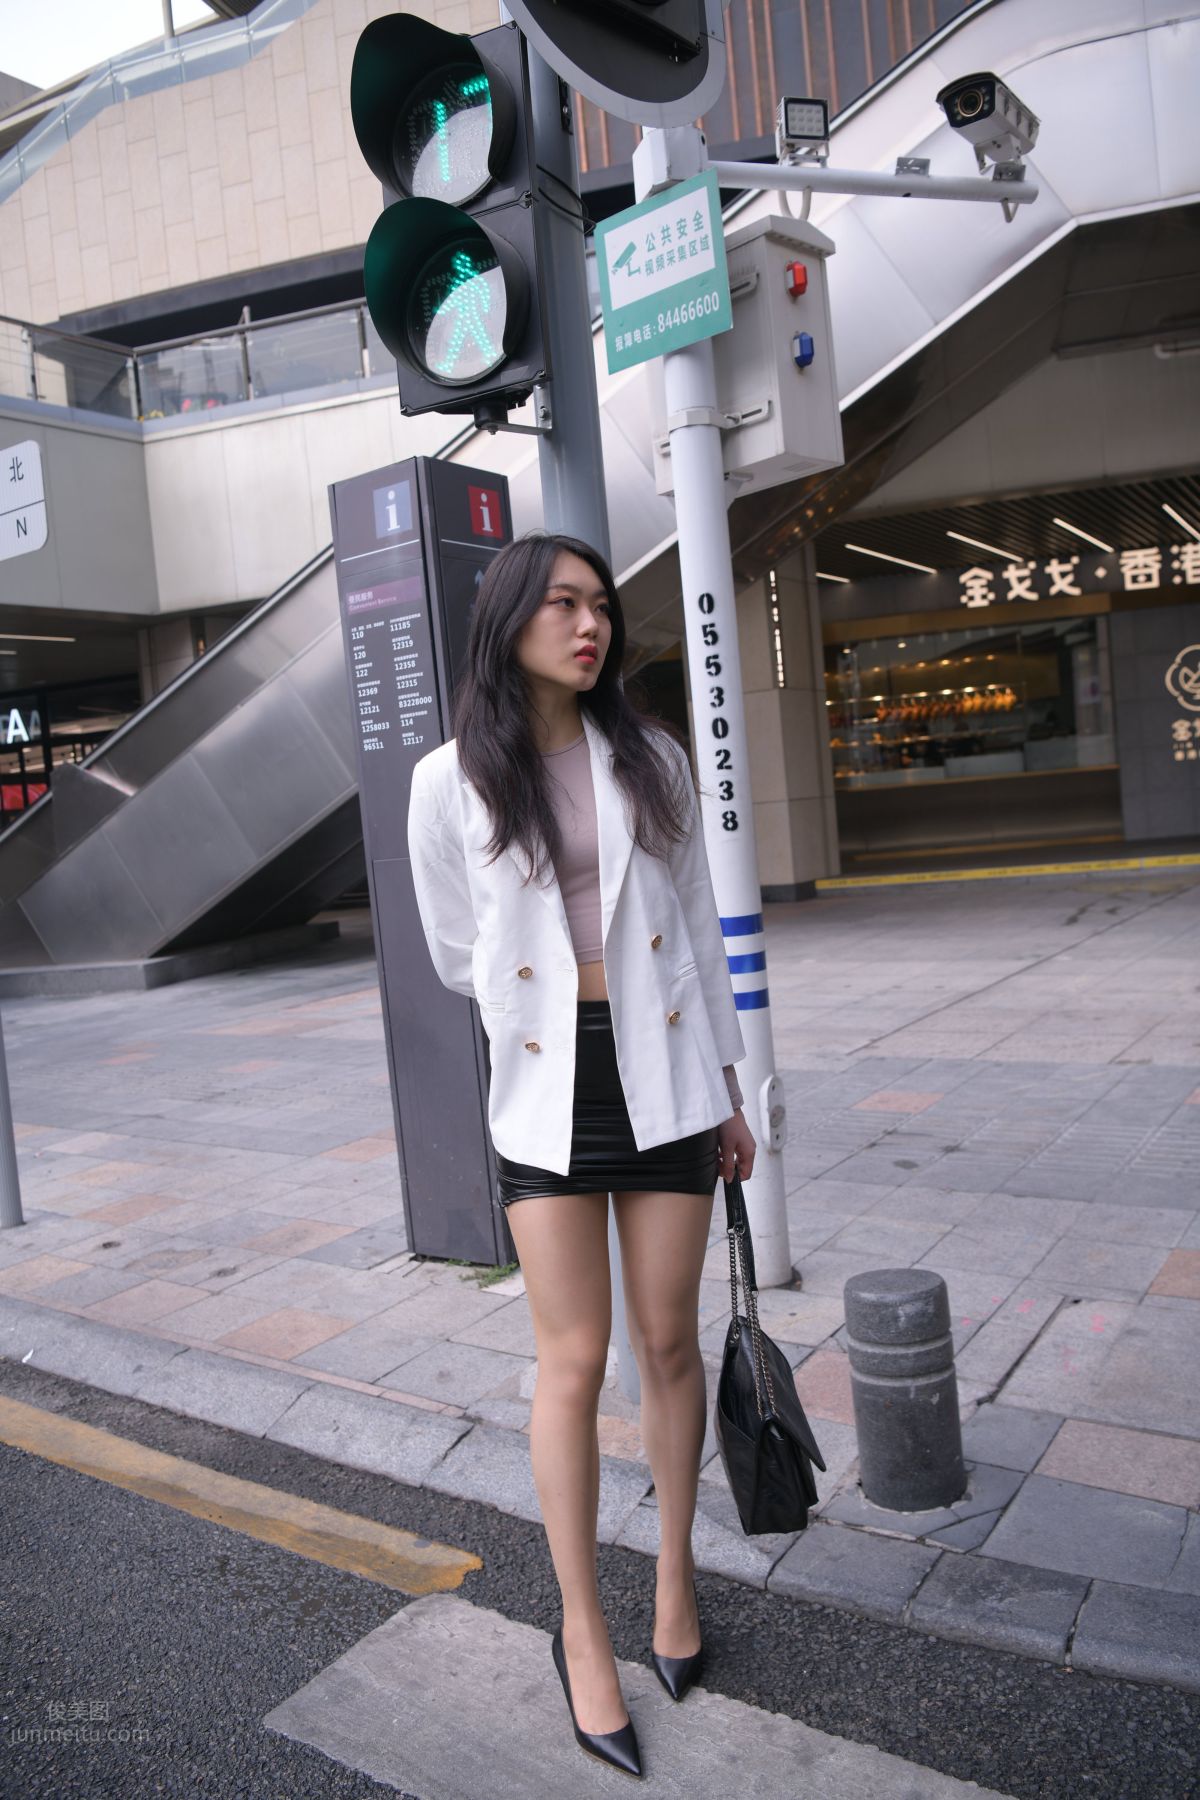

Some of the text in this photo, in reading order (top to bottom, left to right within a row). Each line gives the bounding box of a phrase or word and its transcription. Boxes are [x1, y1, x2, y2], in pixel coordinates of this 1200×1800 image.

[645, 210, 704, 253] 公共安全
[644, 234, 711, 277] 视频采集区域
[9, 456, 24, 482] 北
[16, 516, 28, 538] N
[390, 621, 411, 632] 11185
[352, 631, 364, 640] 110
[392, 640, 414, 651] 12319
[354, 651, 366, 660] 120
[394, 660, 416, 671] 12358
[356, 669, 368, 678] 122
[397, 679, 418, 689] 12315
[358, 687, 378, 697] 12369
[360, 705, 380, 715] 12121
[362, 722, 390, 733] 1258033
[400, 718, 414, 727] 114
[403, 736, 424, 746] 12117
